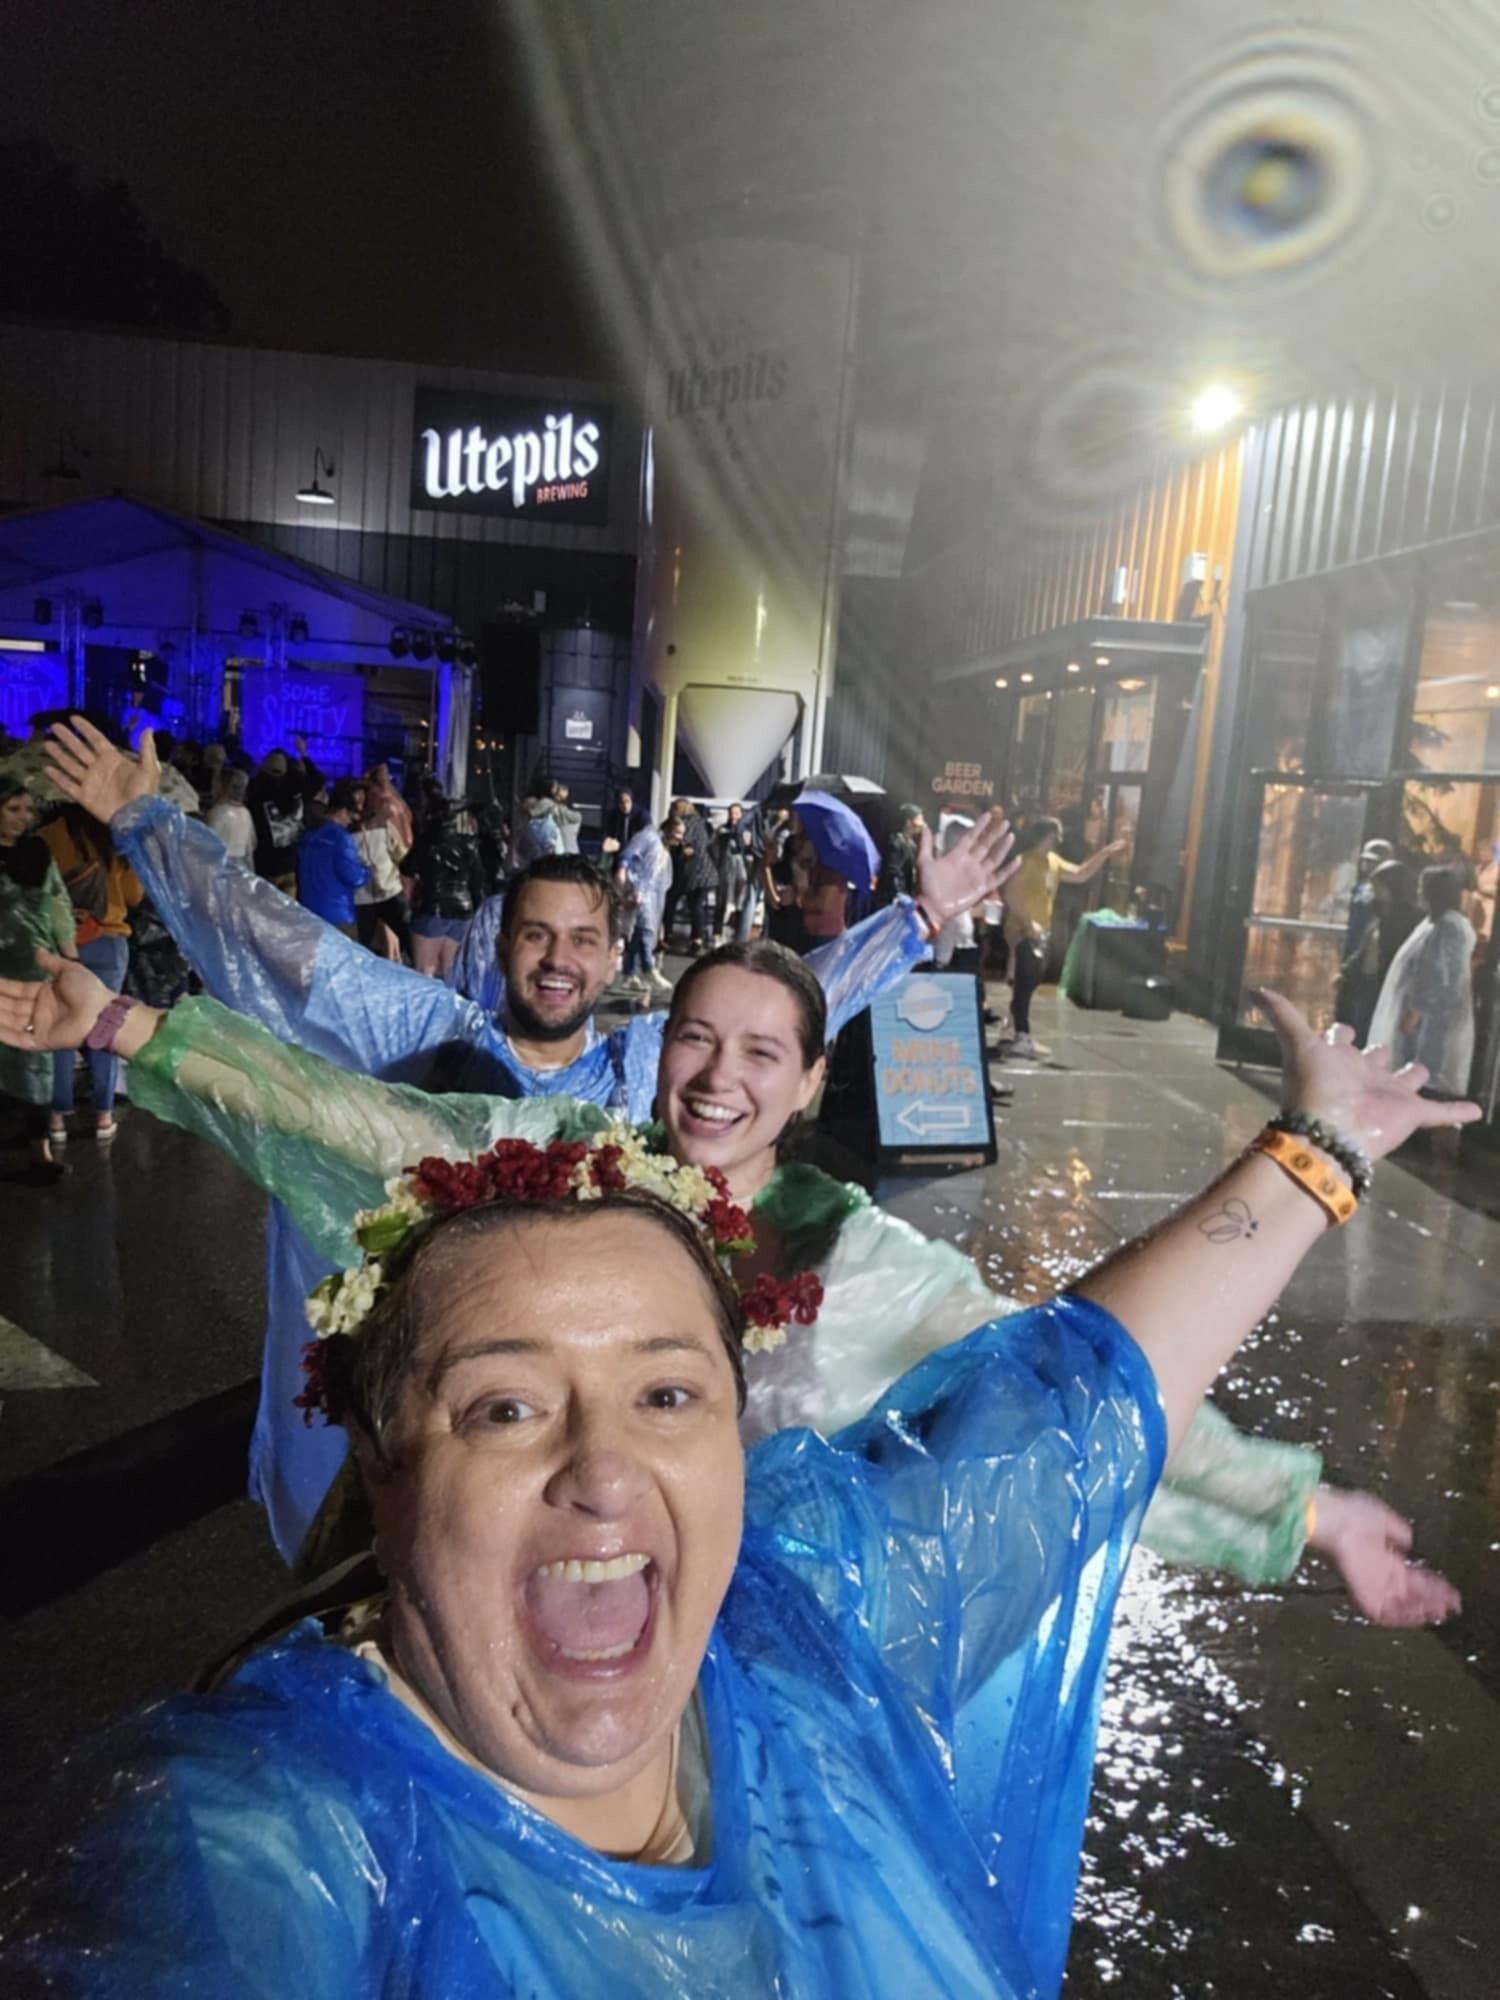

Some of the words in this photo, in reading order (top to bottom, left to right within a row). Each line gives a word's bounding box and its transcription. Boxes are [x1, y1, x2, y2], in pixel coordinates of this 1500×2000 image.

[421, 412, 600, 509] Utepils
[536, 481, 588, 504] BREWING
[281, 682, 331, 702] SOME
[944, 762, 982, 778] BEER
[931, 777, 994, 796] GARDEN
[882, 1066, 977, 1097] DONUTS
